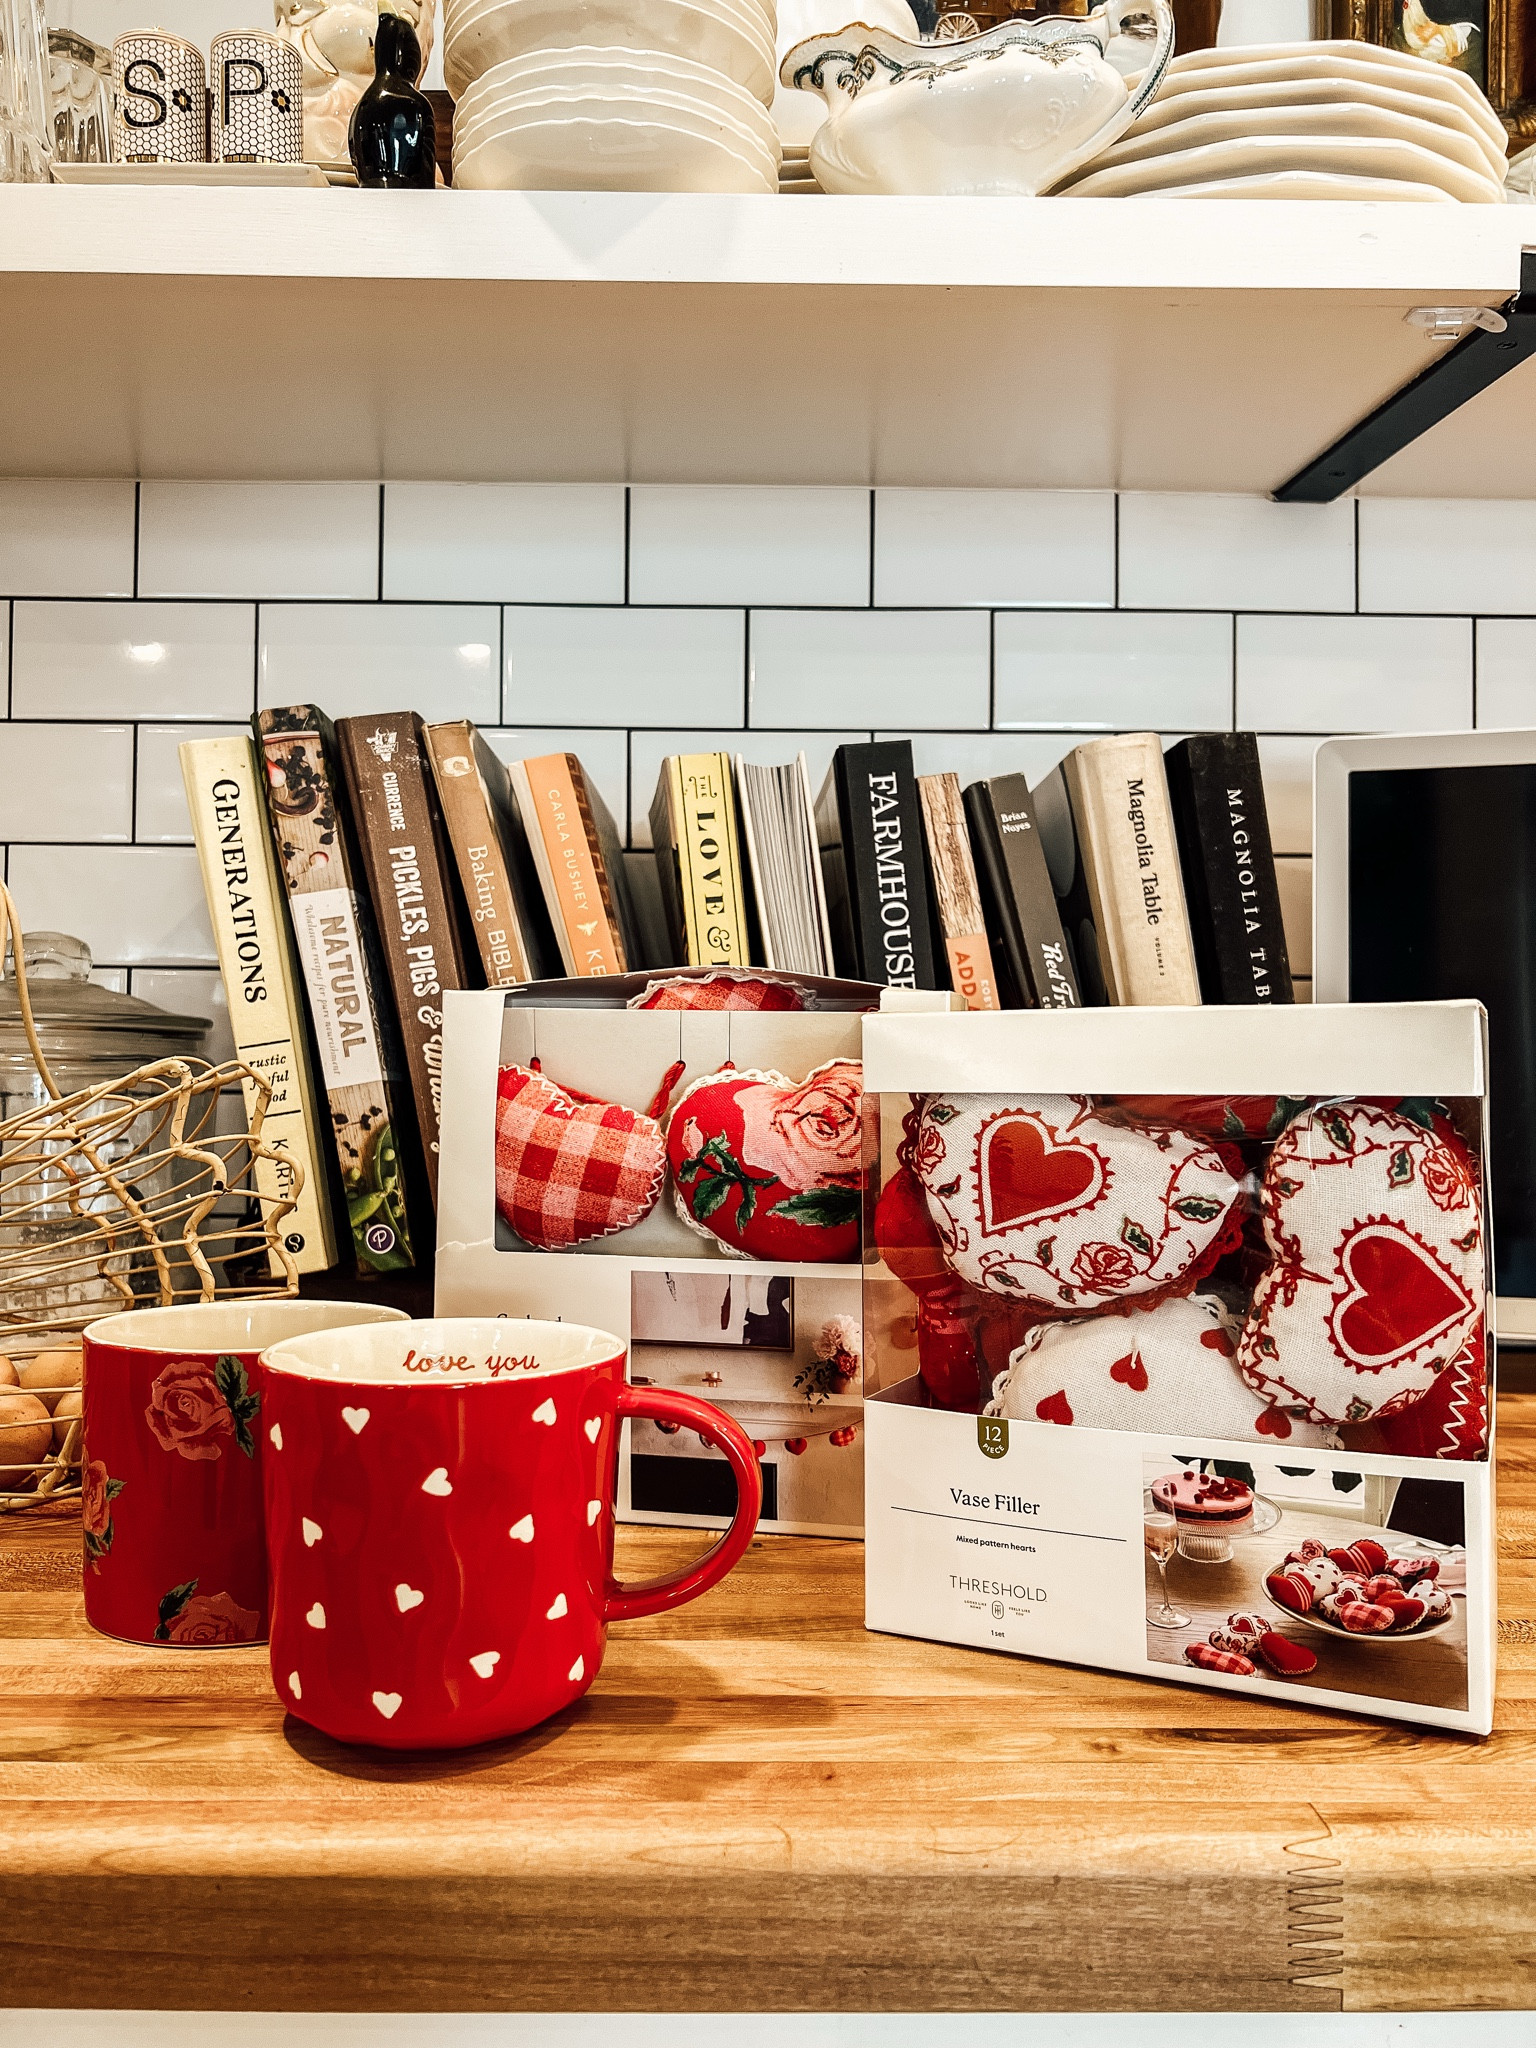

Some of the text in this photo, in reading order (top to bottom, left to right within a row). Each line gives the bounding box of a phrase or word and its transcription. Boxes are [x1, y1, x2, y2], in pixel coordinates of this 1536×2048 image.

[122, 59, 168, 129] S
[221, 59, 268, 129] P
[382, 771, 406, 832] CURRENCE
[1000, 811, 1028, 823] Brian
[1001, 821, 1032, 834] Noyes
[547, 789, 590, 911] CARLA BUSHEY
[696, 809, 726, 916] LOVE
[1127, 777, 1163, 926] Magnolia Table
[212, 778, 267, 1004] GENERATIONS
[388, 845, 430, 942] PICKLES,
[467, 844, 497, 923] Baking
[1226, 788, 1273, 1004] MAGNOLIA TAB
[706, 926, 732, 953] &
[1041, 941, 1066, 981] Red
[319, 915, 368, 1058] NATURAL
[406, 944, 441, 998] PIGS
[954, 951, 977, 997] ADD
[417, 1005, 443, 1030] &
[249, 1054, 287, 1067] rustic
[402, 1349, 540, 1378] love you
[982, 1442, 1005, 1454] PIECE
[984, 1425, 1002, 1442] 12
[949, 1487, 1041, 1516] Vase Filler
[955, 1534, 1037, 1553] Mixed pattern hearts
[949, 1574, 1047, 1602] THRESHOLD
[994, 1630, 1006, 1638] set
